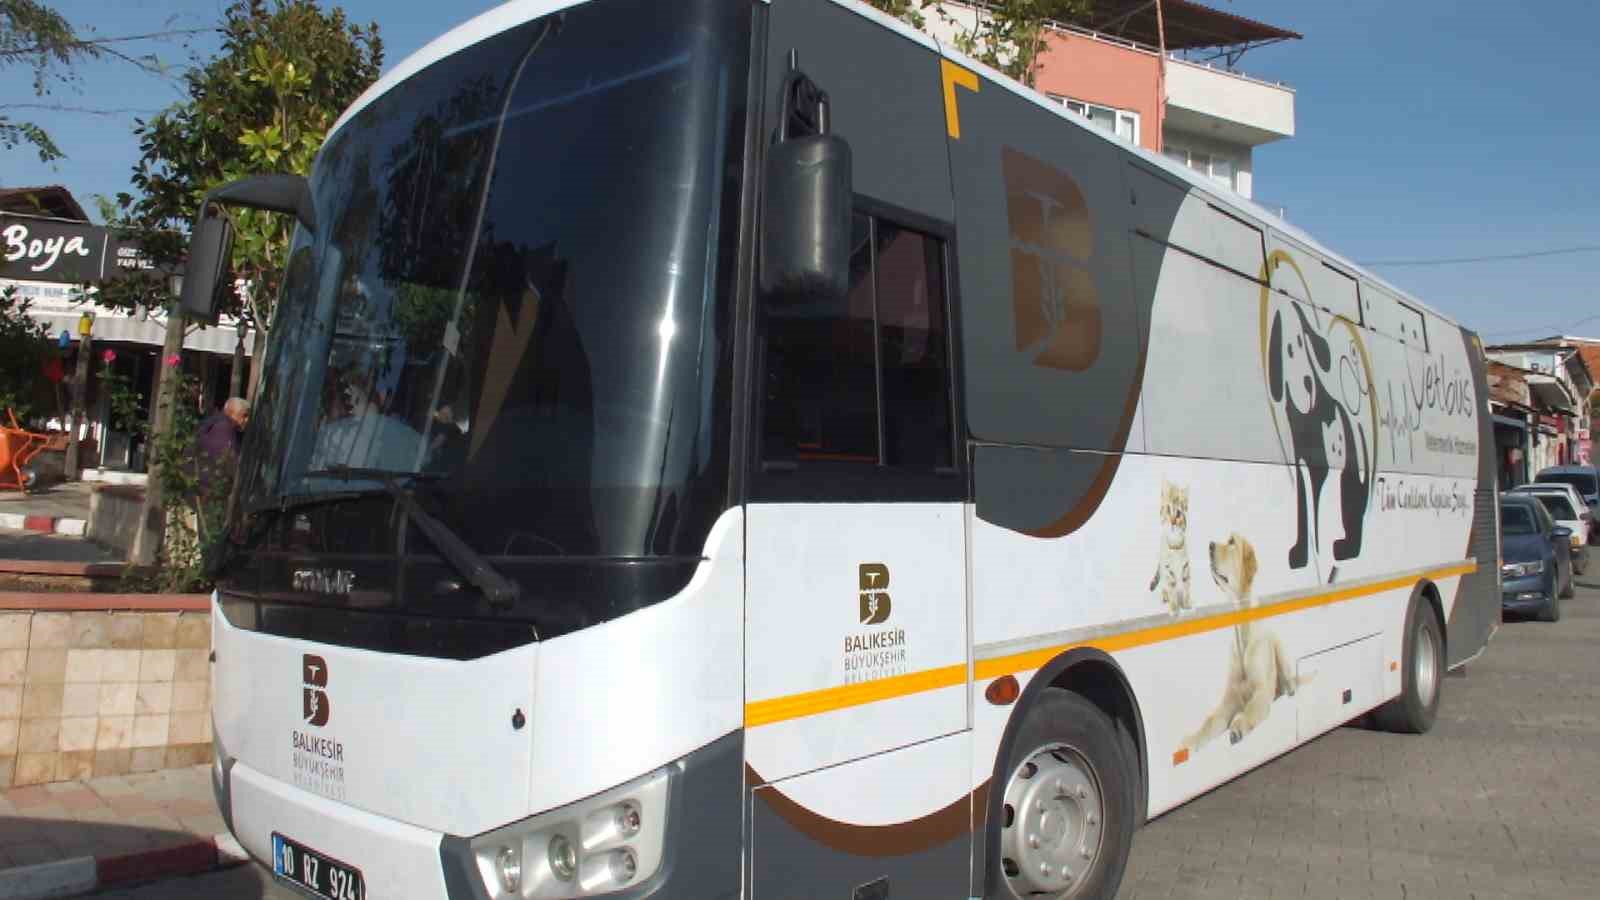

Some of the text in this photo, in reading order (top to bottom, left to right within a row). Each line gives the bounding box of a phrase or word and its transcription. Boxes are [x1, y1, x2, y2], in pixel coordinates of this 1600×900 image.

[3, 224, 90, 272] Boya
[844, 627, 905, 653] BALIKESİR
[292, 730, 344, 761] BALIKESİR
[283, 843, 356, 900] 10 RZ 924
